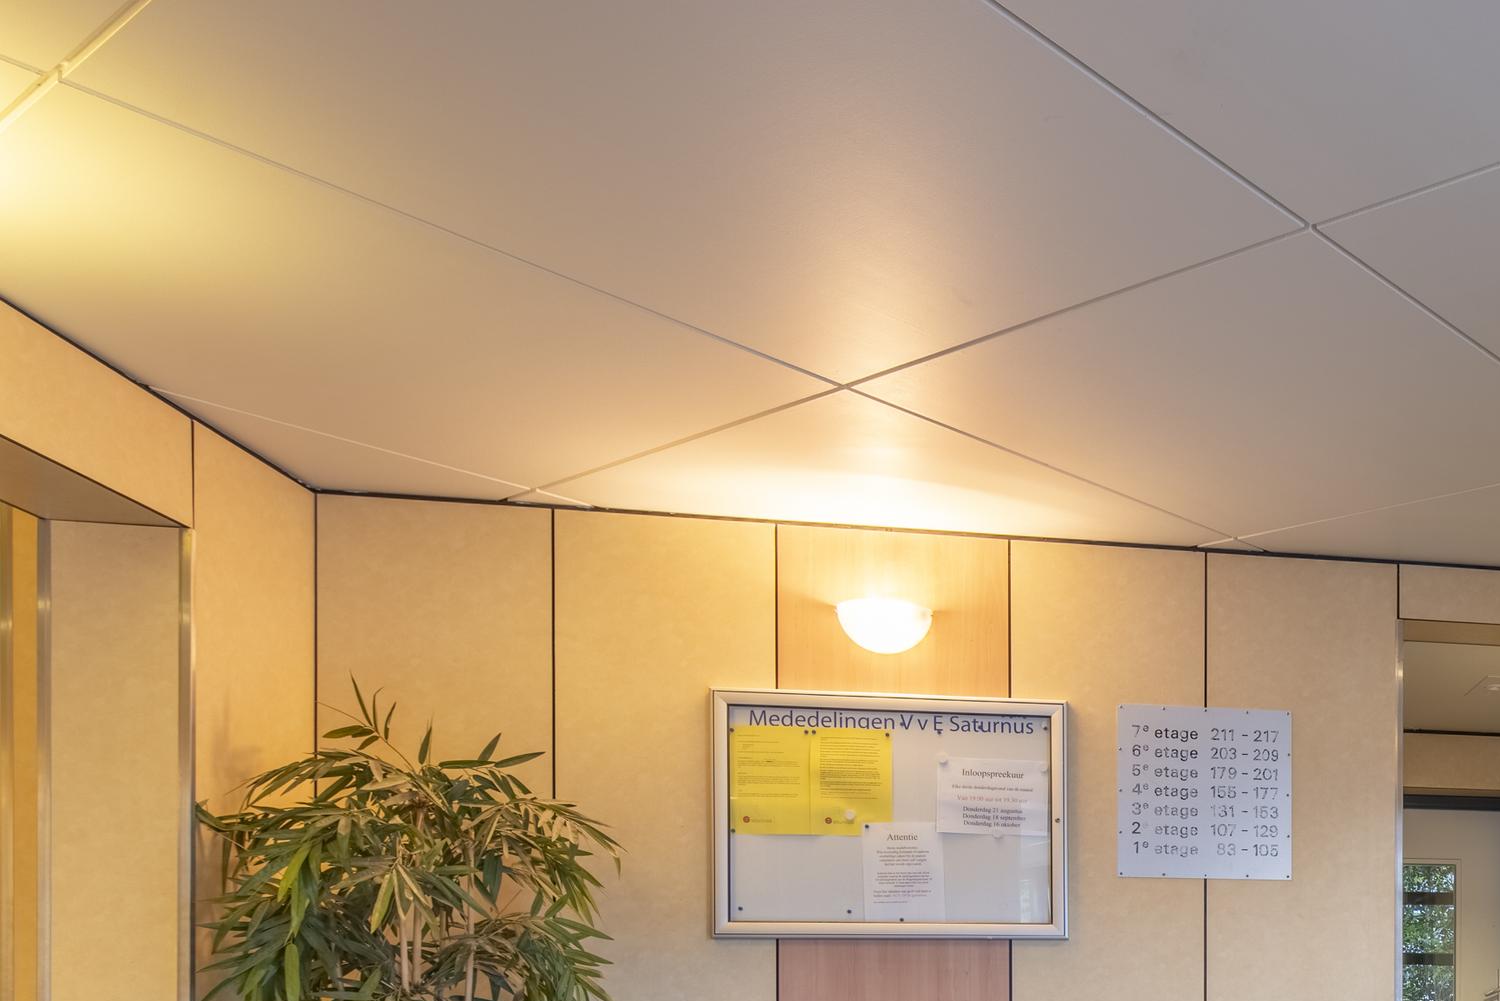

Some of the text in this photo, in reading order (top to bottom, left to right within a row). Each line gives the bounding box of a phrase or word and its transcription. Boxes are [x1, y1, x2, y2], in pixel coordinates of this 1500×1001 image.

[749, 710, 895, 730] Mededelingen
[950, 716, 1034, 735] Saturnus
[1154, 728, 1199, 742] etage
[1210, 727, 1235, 741] 211
[1253, 730, 1279, 743] 217
[1154, 747, 1199, 762] etage
[1210, 747, 1237, 760] 203
[1253, 749, 1279, 762] 209
[962, 769, 1024, 779] Inloopspreekuur
[1154, 767, 1199, 781] etage
[1210, 766, 1237, 780] 179
[1253, 768, 1279, 781] 201
[1154, 785, 1199, 800] etage
[1210, 786, 1237, 799] 155
[1253, 787, 1279, 800] 177
[1154, 804, 1199, 819] etage
[1210, 805, 1235, 818] 131
[1253, 806, 1279, 819] 153
[887, 833, 919, 841] Attentie
[1154, 824, 1199, 838] etage
[1210, 824, 1237, 837] 107
[1253, 825, 1279, 838] 129
[1154, 843, 1199, 858] etage
[1216, 843, 1237, 856] 83
[1253, 844, 1279, 858] 105
